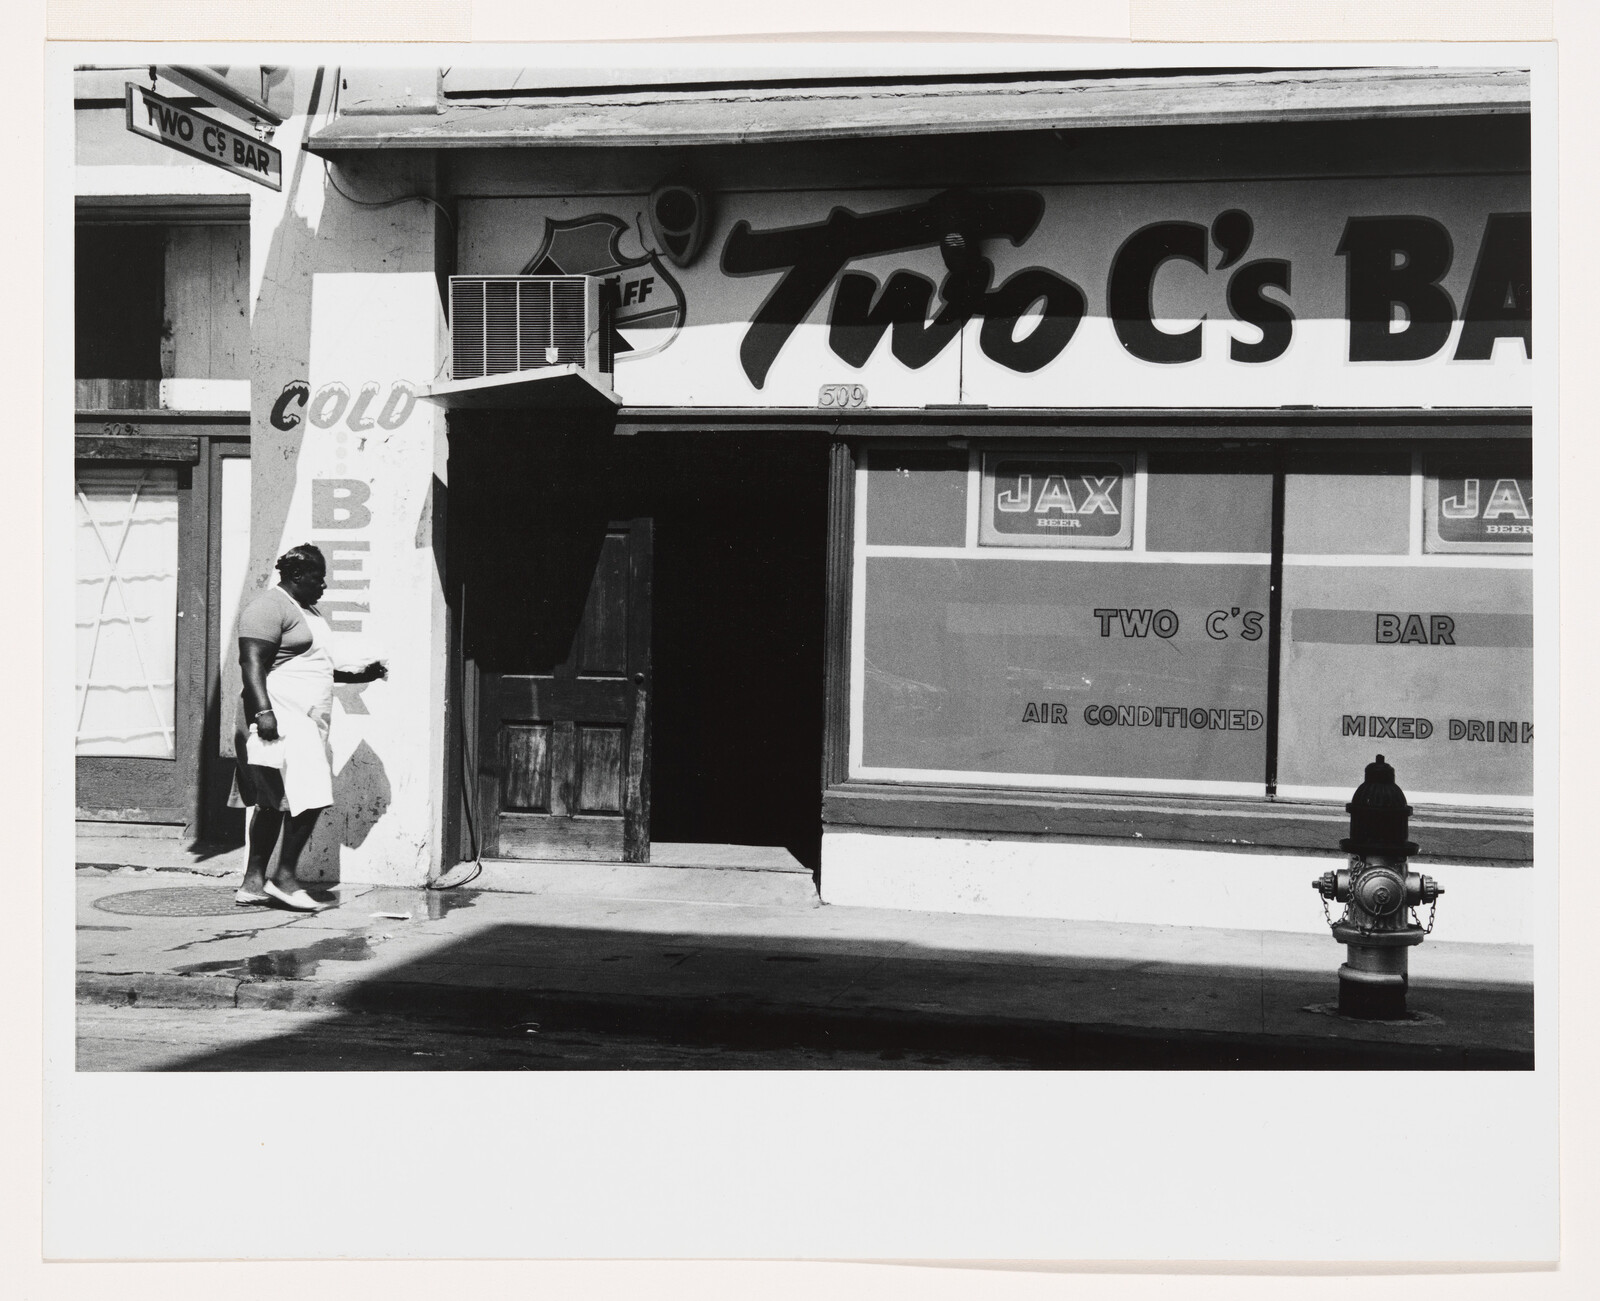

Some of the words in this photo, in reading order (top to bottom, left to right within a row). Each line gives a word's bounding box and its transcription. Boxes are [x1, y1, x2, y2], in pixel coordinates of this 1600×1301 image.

[143, 96, 194, 142] TWO
[233, 137, 269, 176] BAR
[719, 187, 1089, 392] Two
[269, 379, 415, 432] COLD
[820, 386, 865, 408] 509
[997, 474, 1120, 515] JAX
[1442, 478, 1533, 519] JA
[1036, 518, 1082, 528] BEER
[1093, 608, 1179, 639] TWO
[1375, 613, 1456, 646] BAR
[1021, 702, 1068, 725] AIR
[1083, 703, 1264, 731] CONDITIONED
[1342, 714, 1434, 740] MIXED
